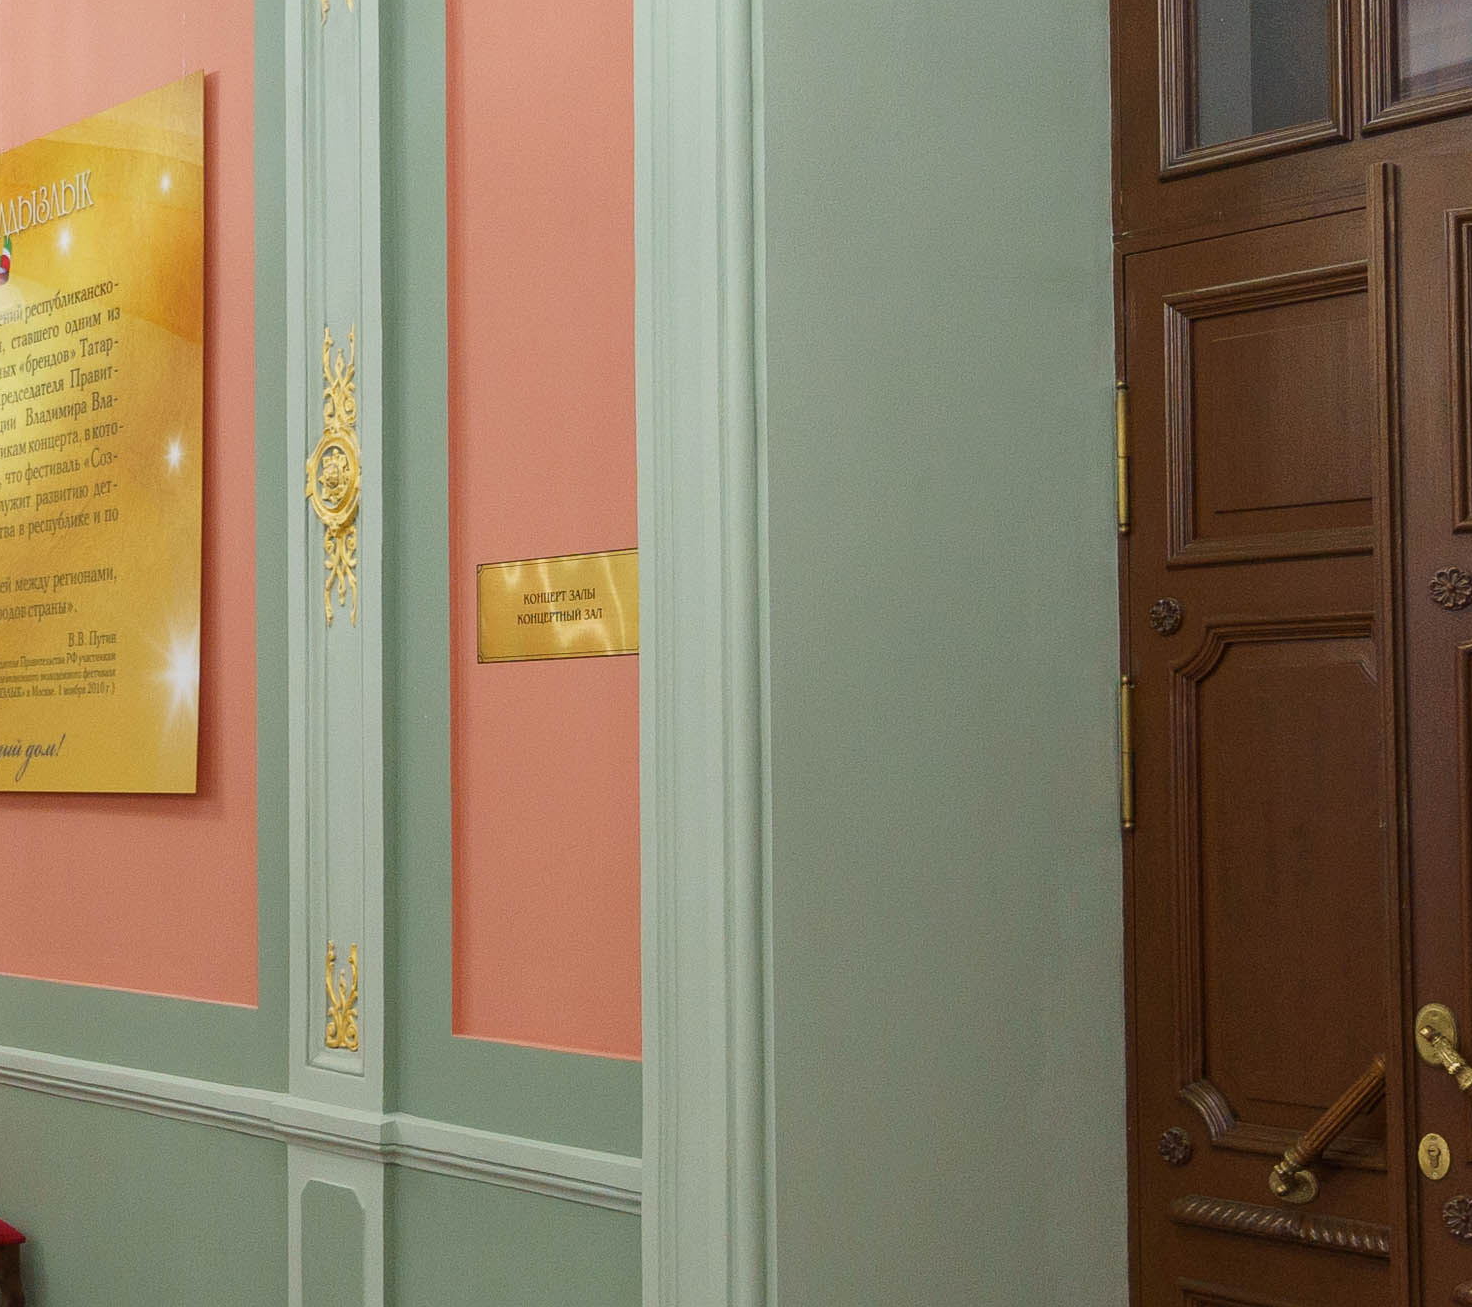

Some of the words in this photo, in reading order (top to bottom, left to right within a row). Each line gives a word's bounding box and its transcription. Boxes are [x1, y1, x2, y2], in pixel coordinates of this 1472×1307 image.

[25, 280, 119, 324] республиканско-
[11, 325, 60, 350] ставшего
[65, 312, 102, 337] одним
[107, 307, 121, 322] из
[19, 349, 76, 376] «брендов»
[80, 336, 119, 359] Татар-
[70, 365, 119, 392] Правит-
[25, 401, 88, 428] Владимира
[92, 391, 119, 413] Вла-
[28, 431, 83, 454] концерта,
[91, 421, 124, 439] кото-
[5, 471, 23, 486] что
[24, 459, 81, 486] фестиваль
[84, 447, 118, 469] «Соз-
[35, 484, 89, 512] развитию
[93, 480, 118, 498] дет-
[18, 525, 25, 536] в
[28, 511, 90, 540] республике
[93, 510, 101, 525] и
[104, 507, 119, 522] по
[15, 576, 51, 594] между
[53, 567, 118, 592] регионами,
[523, 590, 567, 605] КОНЦЕРТ
[569, 587, 596, 602] ЗАЛЫ
[517, 607, 581, 626] КОНЦЕРТНЫЙ
[584, 607, 603, 621] ЗАЛ
[89, 630, 117, 649] Путин
